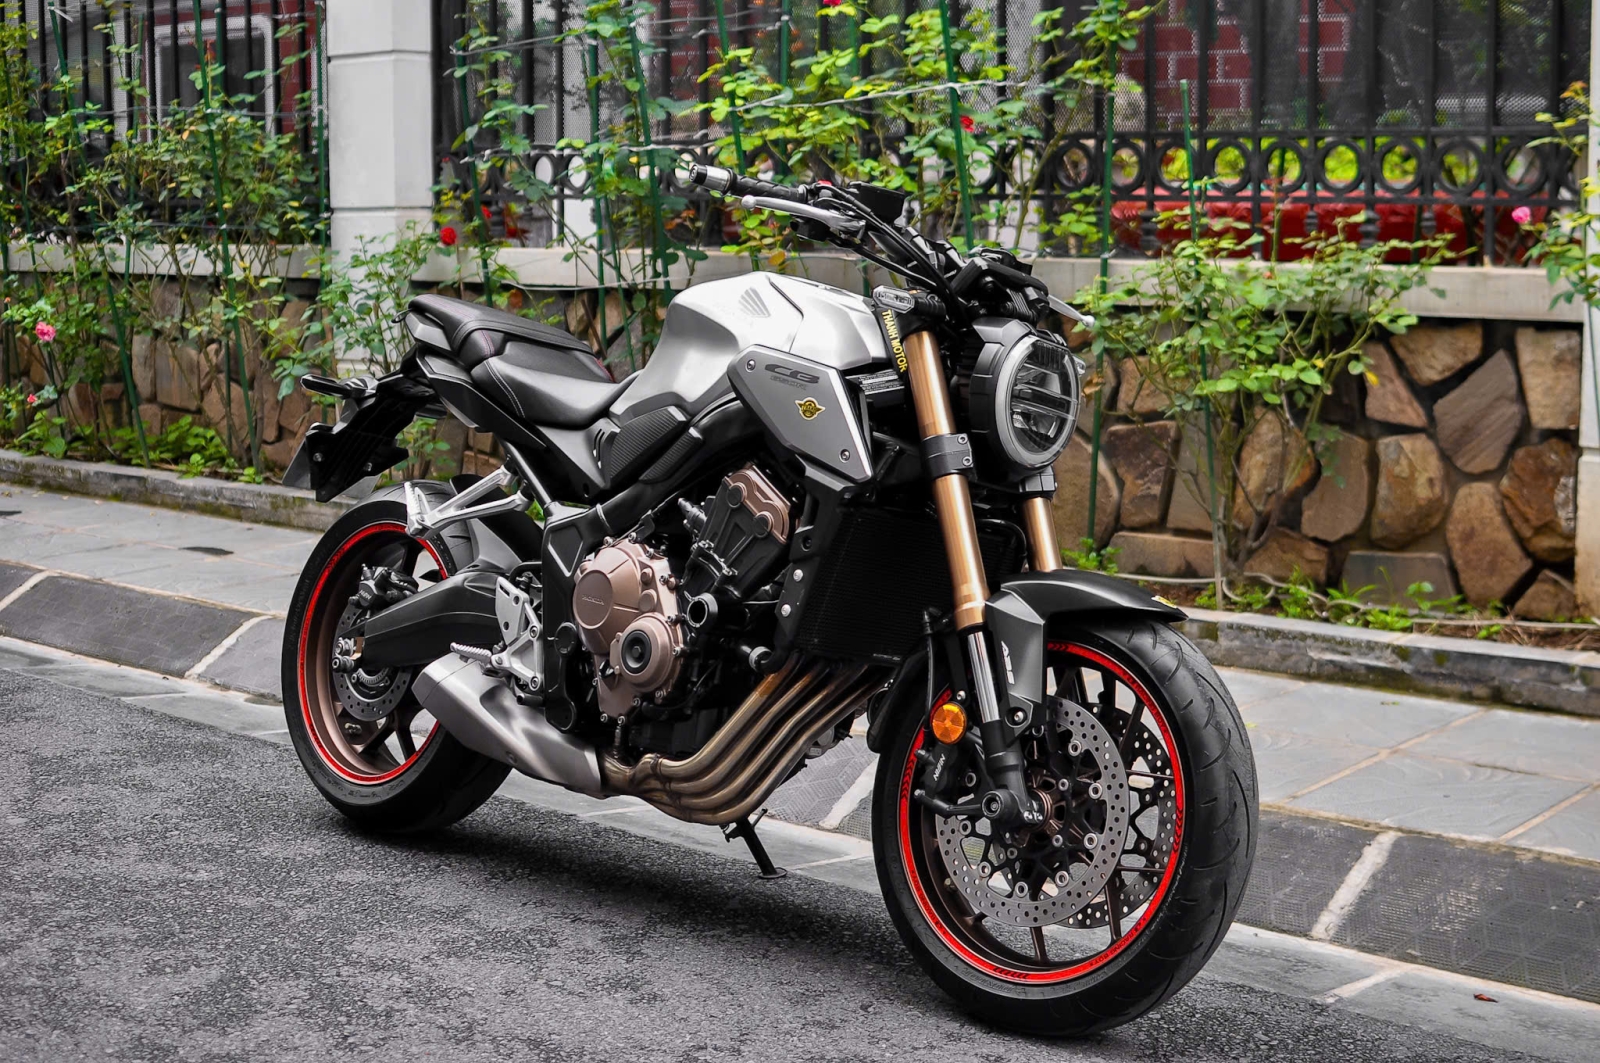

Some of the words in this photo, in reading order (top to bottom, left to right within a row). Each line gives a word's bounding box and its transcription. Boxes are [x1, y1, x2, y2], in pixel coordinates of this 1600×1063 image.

[882, 309, 899, 339] THANH
[891, 339, 908, 373] MOTOR
[765, 363, 820, 384] CB
